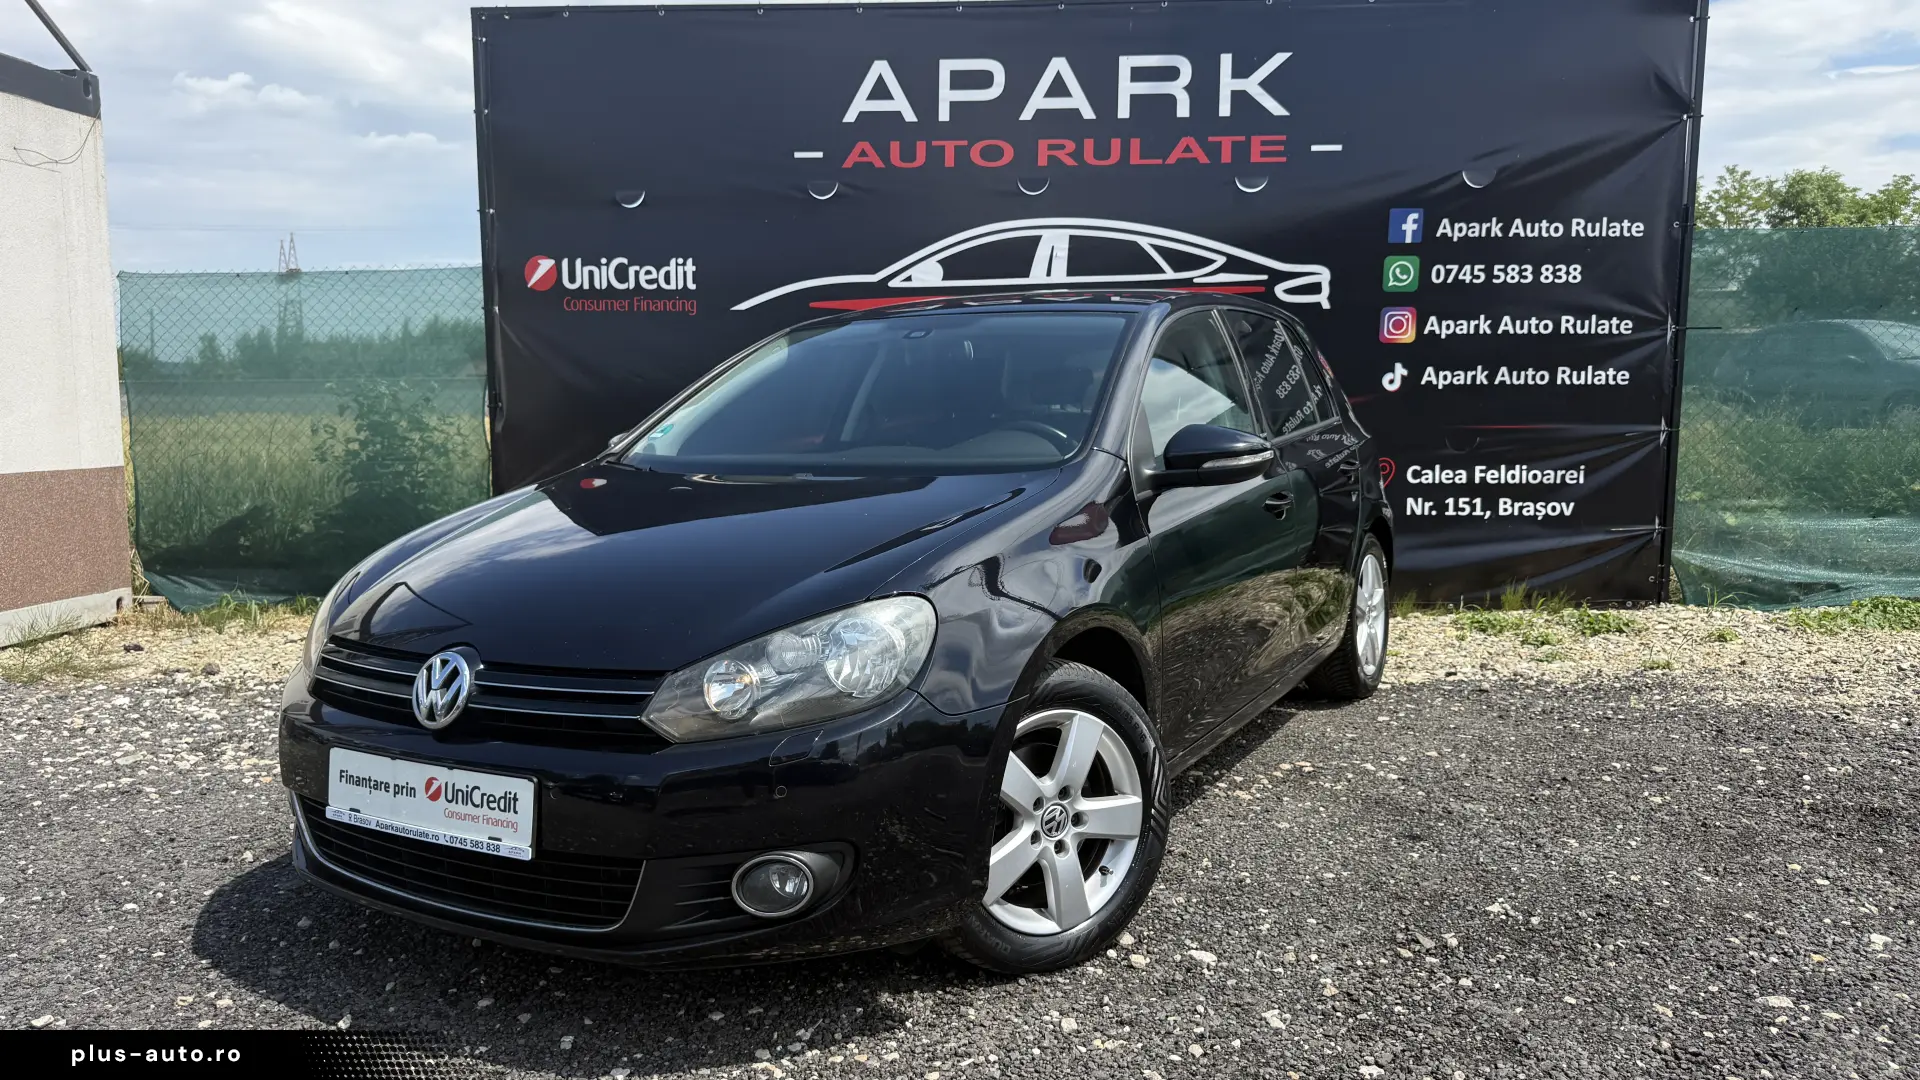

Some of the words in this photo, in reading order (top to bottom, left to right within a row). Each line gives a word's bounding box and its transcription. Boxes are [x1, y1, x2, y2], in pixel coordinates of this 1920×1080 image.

[842, 51, 1293, 123] APARK
[842, 139, 1014, 168] AUTO
[1036, 135, 1288, 167] RULATE
[1435, 217, 1504, 242] Apark
[1508, 217, 1564, 238] Auto
[1570, 216, 1645, 238] Rulate
[561, 256, 697, 290] UniCredit
[1430, 265, 1486, 285] 0745
[1492, 265, 1533, 284] 583
[1539, 264, 1583, 284] 838
[563, 296, 630, 312] Consumer
[633, 296, 697, 316] Financing
[1423, 315, 1492, 340] Apark
[1497, 315, 1553, 335] Auto
[1560, 315, 1633, 335] Rulate
[1420, 365, 1489, 390] Apark
[1494, 366, 1550, 385] Auto
[1556, 365, 1630, 385] Rulate
[1406, 464, 1468, 484] Calea
[1474, 464, 1586, 485] Feldioarei
[1406, 497, 1437, 516] Nr.
[1444, 497, 1491, 519] 151,
[1498, 497, 1575, 520] Brașov
[339, 769, 391, 795] Finanțare
[393, 784, 417, 799] prin
[444, 781, 519, 815] UniCredit
[443, 807, 481, 824] Consumer
[482, 815, 519, 833] Financing
[375, 819, 440, 842] Aparkautorulate.ro
[449, 835, 468, 848] 0745
[469, 840, 485, 851] 583
[486, 843, 501, 854] 838
